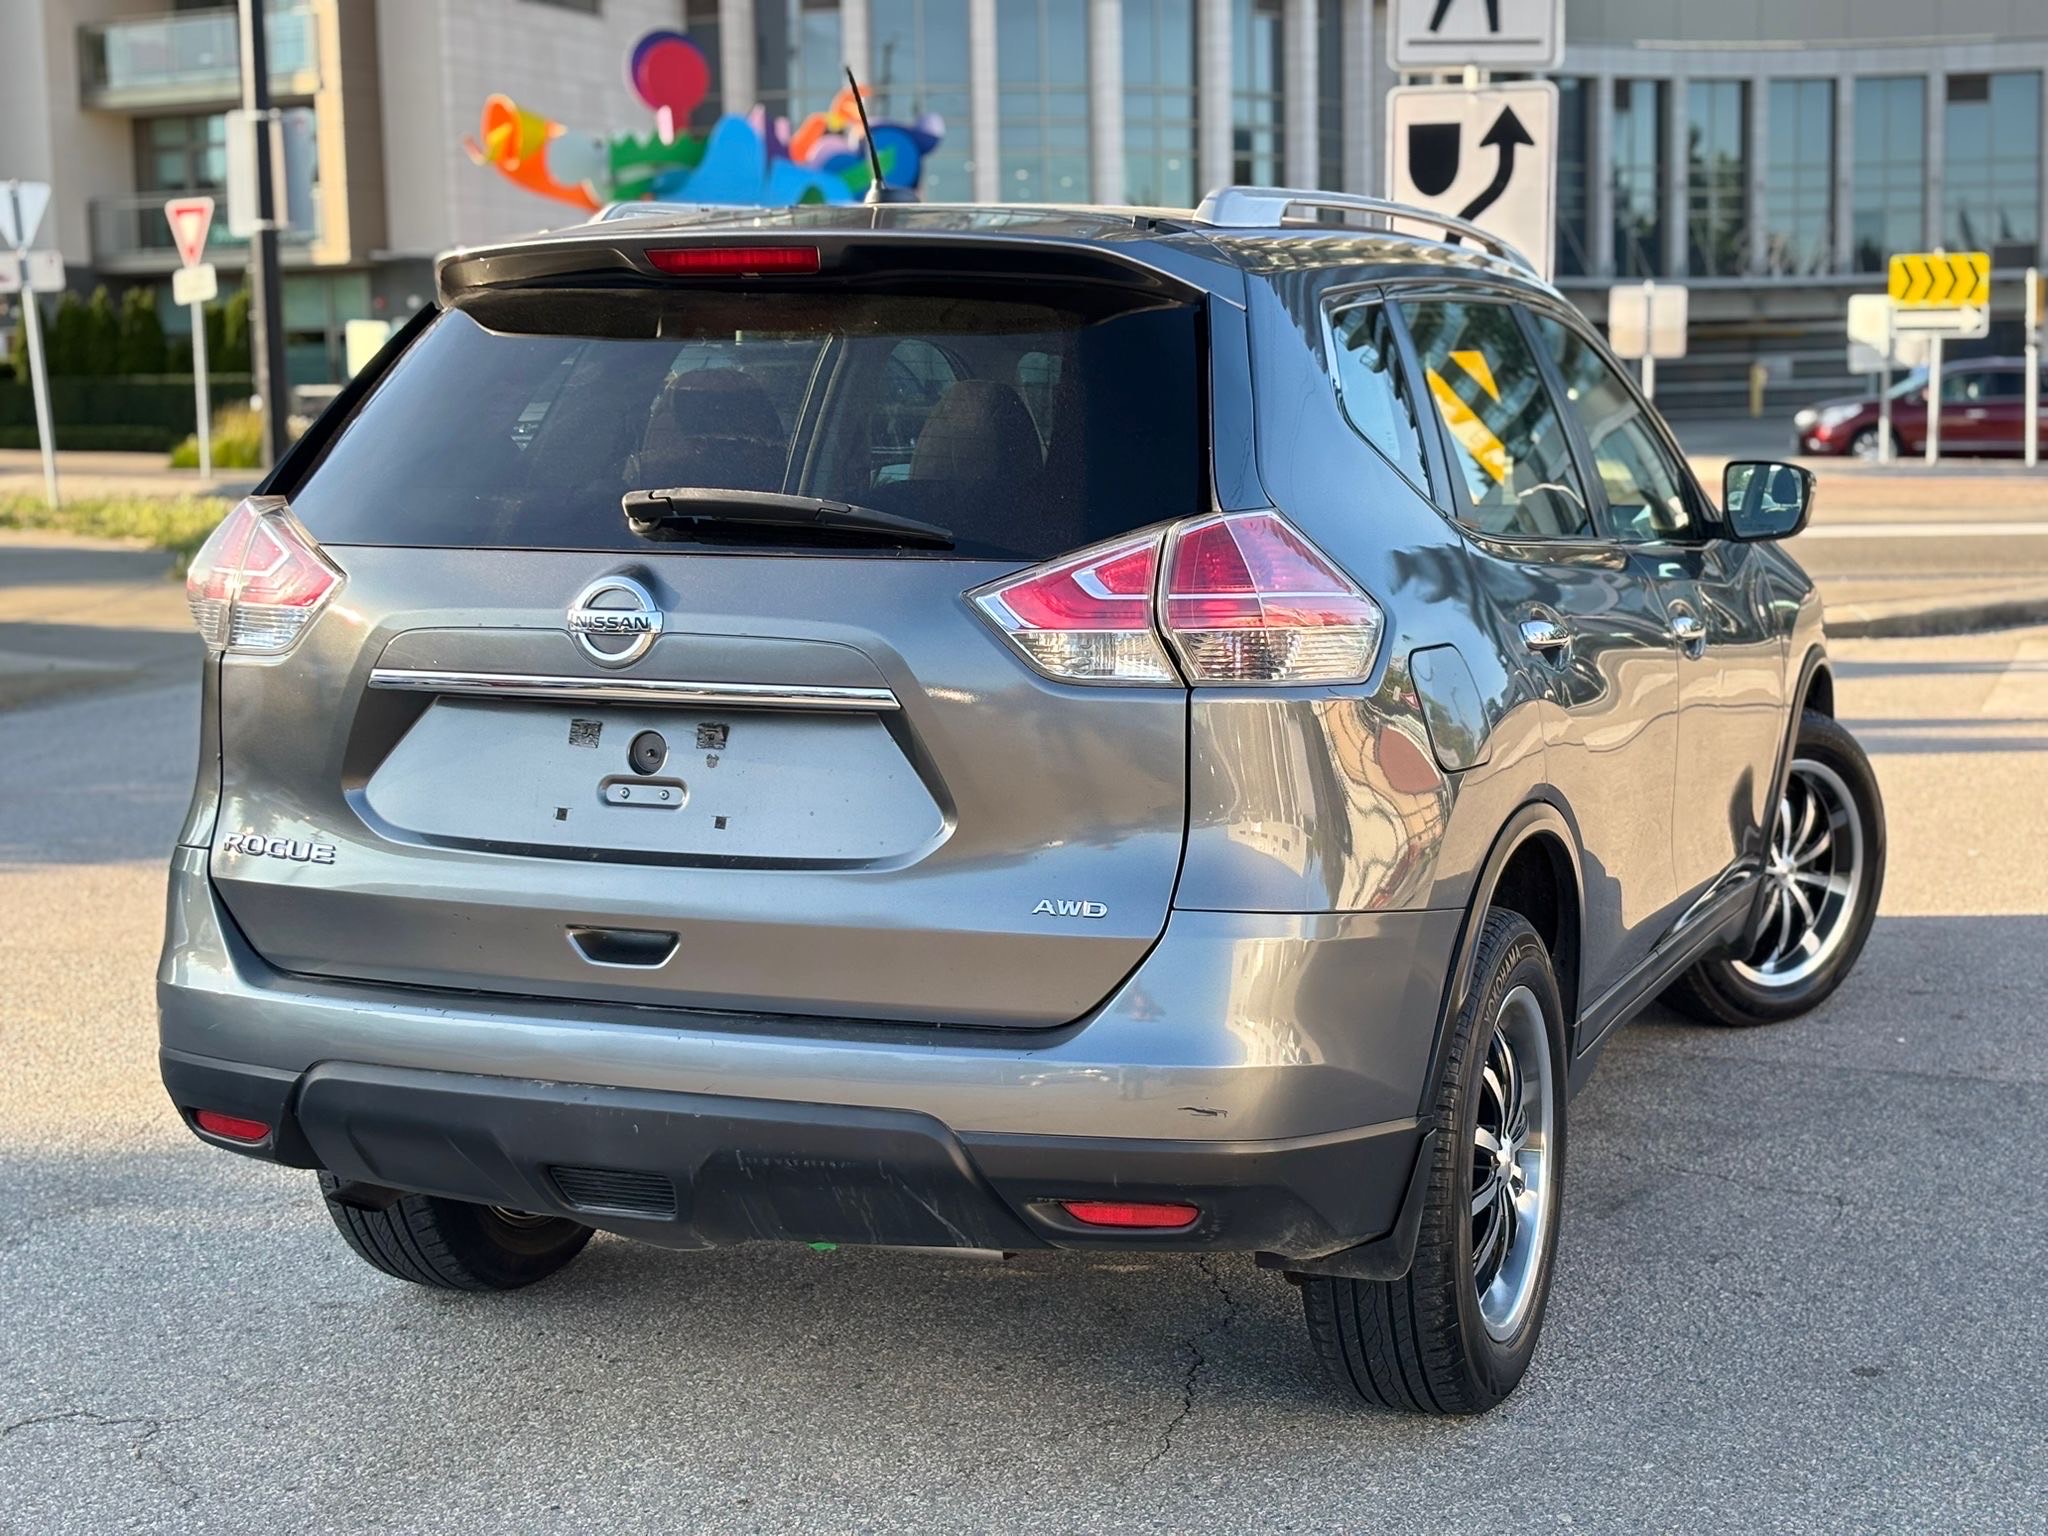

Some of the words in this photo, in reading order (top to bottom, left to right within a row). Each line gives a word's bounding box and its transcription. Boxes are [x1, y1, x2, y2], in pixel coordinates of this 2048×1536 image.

[574, 615, 649, 630] NISSAN
[224, 832, 336, 864] ROGUE
[1032, 899, 1108, 918] AWD
[1484, 944, 1522, 1024] YOKOHAMA
